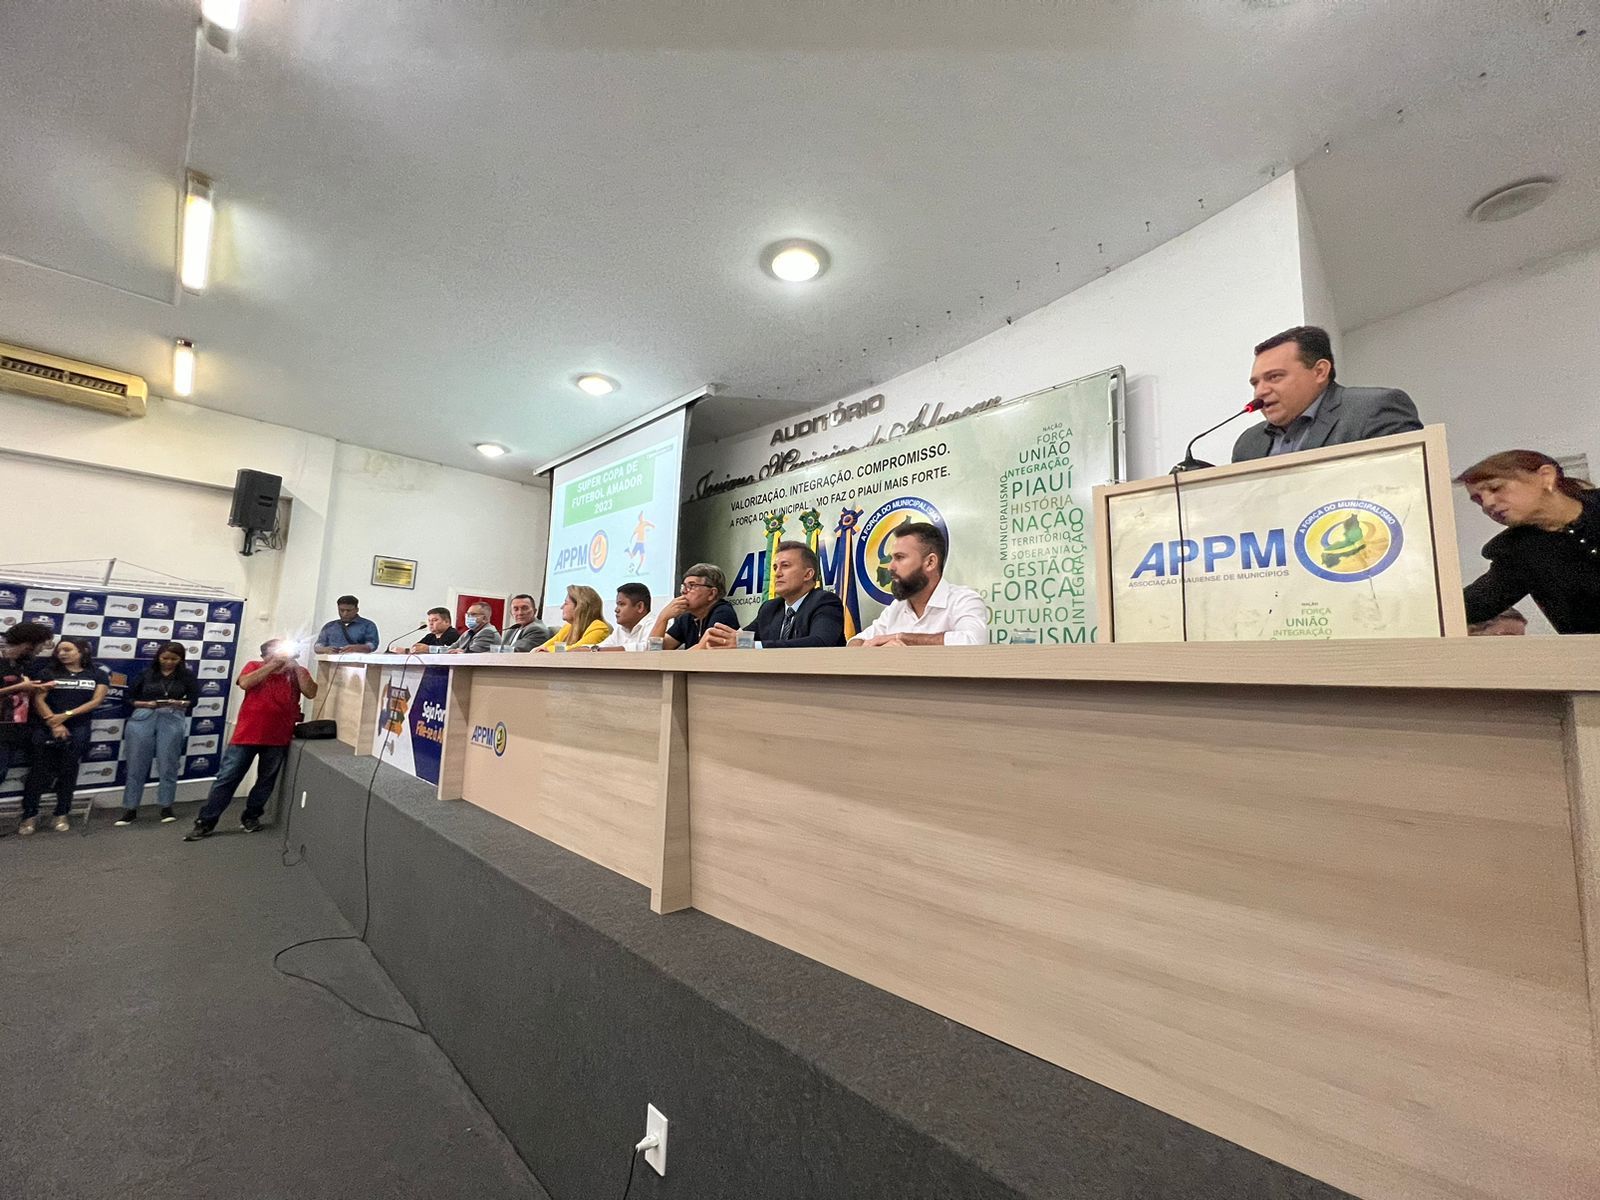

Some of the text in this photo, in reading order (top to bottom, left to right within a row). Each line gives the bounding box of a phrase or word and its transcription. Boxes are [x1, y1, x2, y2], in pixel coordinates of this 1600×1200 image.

[770, 393, 885, 446] AUDITÓRIO
[1042, 422, 1063, 432] NAÇÃO
[1037, 428, 1073, 444] FORÇA
[1019, 441, 1071, 464] UNIÃO
[577, 460, 639, 493] SUPER COPA DE
[730, 442, 951, 511] VALORIZAÇÃO. INTEGRAÇÃO. COMPROMISSO.
[1004, 457, 1070, 478] INTEGRAÇÃO
[571, 473, 643, 509] FUTEBOL AMADOR
[1012, 464, 1074, 499] PIAUÍ
[594, 500, 613, 514] 2023
[735, 513, 758, 526] FORÇA
[831, 491, 846, 504] FAZ
[848, 489, 856, 499] O
[858, 481, 882, 497] PIAUÍ
[884, 475, 909, 491] MAIS
[912, 466, 951, 485] FORTE.
[1011, 494, 1074, 515] HISTÓRIA
[863, 513, 882, 535] FORÇA
[881, 504, 892, 515] DO
[892, 499, 941, 523] MUNICIPALISMO
[1000, 475, 1008, 560] MUNICIPALISMO
[1012, 506, 1084, 534] NAÇÃO
[1302, 510, 1324, 528] FORÇA
[1324, 504, 1336, 513] DO
[1337, 501, 1396, 525] MUNICIPALISMO
[1011, 531, 1071, 546] TERRITÓRIO
[554, 544, 588, 571] APPM
[1011, 545, 1071, 560] SOBERANIA
[1130, 528, 1287, 579] APPM
[1003, 555, 1074, 579] GESTÃO
[1071, 522, 1088, 624] INTEGRAÇÃO
[1128, 578, 1177, 588] ASSOCIAÇÃO
[1237, 569, 1289, 580] MUNICÍPIOS
[992, 576, 1076, 604] FORÇA
[994, 607, 1069, 625] FUTURO
[1286, 616, 1329, 627] UNIÃO
[1301, 607, 1331, 616] FORÇA
[1273, 627, 1332, 637] INTEGRAÇÃO
[470, 725, 494, 746] APPM
